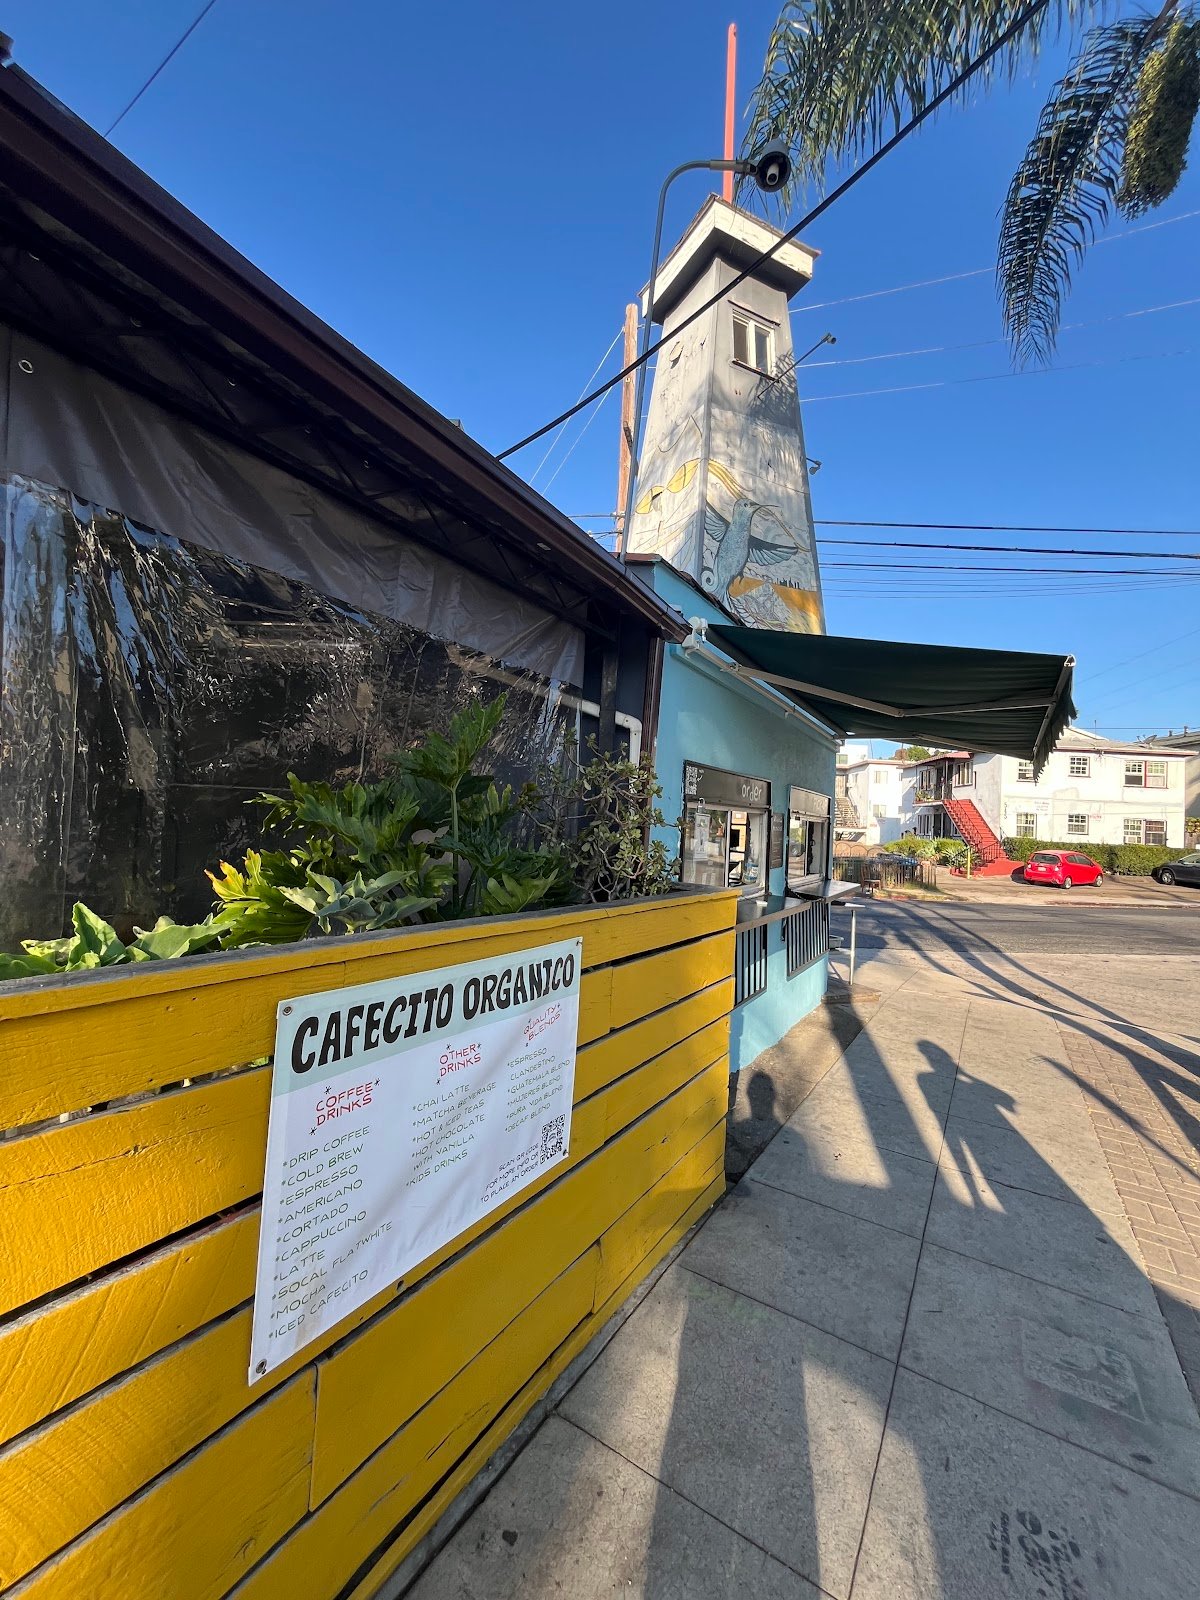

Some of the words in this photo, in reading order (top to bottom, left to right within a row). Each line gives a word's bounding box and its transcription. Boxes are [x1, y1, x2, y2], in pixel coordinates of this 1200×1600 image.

[742, 784, 762, 801] order
[291, 983, 454, 1074] CAFECITO
[463, 953, 575, 1020] ORGANICO
[524, 1004, 556, 1035] QUALITY
[529, 1011, 560, 1040] BLENDS
[440, 1043, 476, 1065] OTHER
[440, 1053, 481, 1077] DRINKS
[510, 1047, 547, 1068] ESPRESSO
[511, 1055, 555, 1081] CLANDESTINO
[511, 1070, 549, 1094] GUATEMALA
[551, 1059, 570, 1074] BLEND
[541, 1075, 561, 1090] BLEND
[316, 1082, 373, 1112] COFFEE
[316, 1093, 372, 1126] DRINKS
[417, 1096, 439, 1112] CHAI
[442, 1084, 470, 1102] LATTE
[417, 1104, 455, 1128] MATCHA
[458, 1081, 497, 1109] BEVERAGE
[508, 1105, 526, 1119] PURA
[543, 1085, 563, 1100] BLEND
[417, 1126, 436, 1143] HOT
[438, 1122, 443, 1132] &
[445, 1113, 462, 1126] ICED
[464, 1099, 485, 1115] TEAS
[507, 1114, 529, 1133] DECAF
[530, 1102, 551, 1120] BLEND
[289, 1148, 318, 1168] DRIP
[323, 1126, 370, 1153] COFFEE
[413, 1154, 433, 1172] WITH
[436, 1133, 475, 1156] VANILLA
[416, 1141, 434, 1158] HOT
[435, 1114, 485, 1145] CHOCOLATE
[287, 1163, 324, 1186] COLD
[328, 1143, 364, 1168] BREW
[409, 1167, 431, 1186] KIDS
[434, 1149, 468, 1173] DRINKS
[485, 1177, 499, 1191] FOR
[499, 1166, 516, 1181] MORE
[530, 1151, 539, 1163] OR
[499, 1158, 515, 1172] SCAN
[285, 1164, 358, 1205] ESPRESSO
[481, 1194, 490, 1203] TO
[490, 1182, 510, 1198] PLACE
[511, 1174, 520, 1184] AN
[520, 1162, 539, 1177] ORDER
[284, 1179, 363, 1224] AMERICANO
[281, 1210, 367, 1262] CAPPUCCINO
[282, 1203, 349, 1243] CORTADO
[279, 1249, 326, 1281] LATTE
[278, 1268, 328, 1299] SOCAL
[275, 1314, 305, 1338] ICED
[310, 1269, 368, 1315] CAFECITO
[276, 1284, 326, 1319] MOCHA
